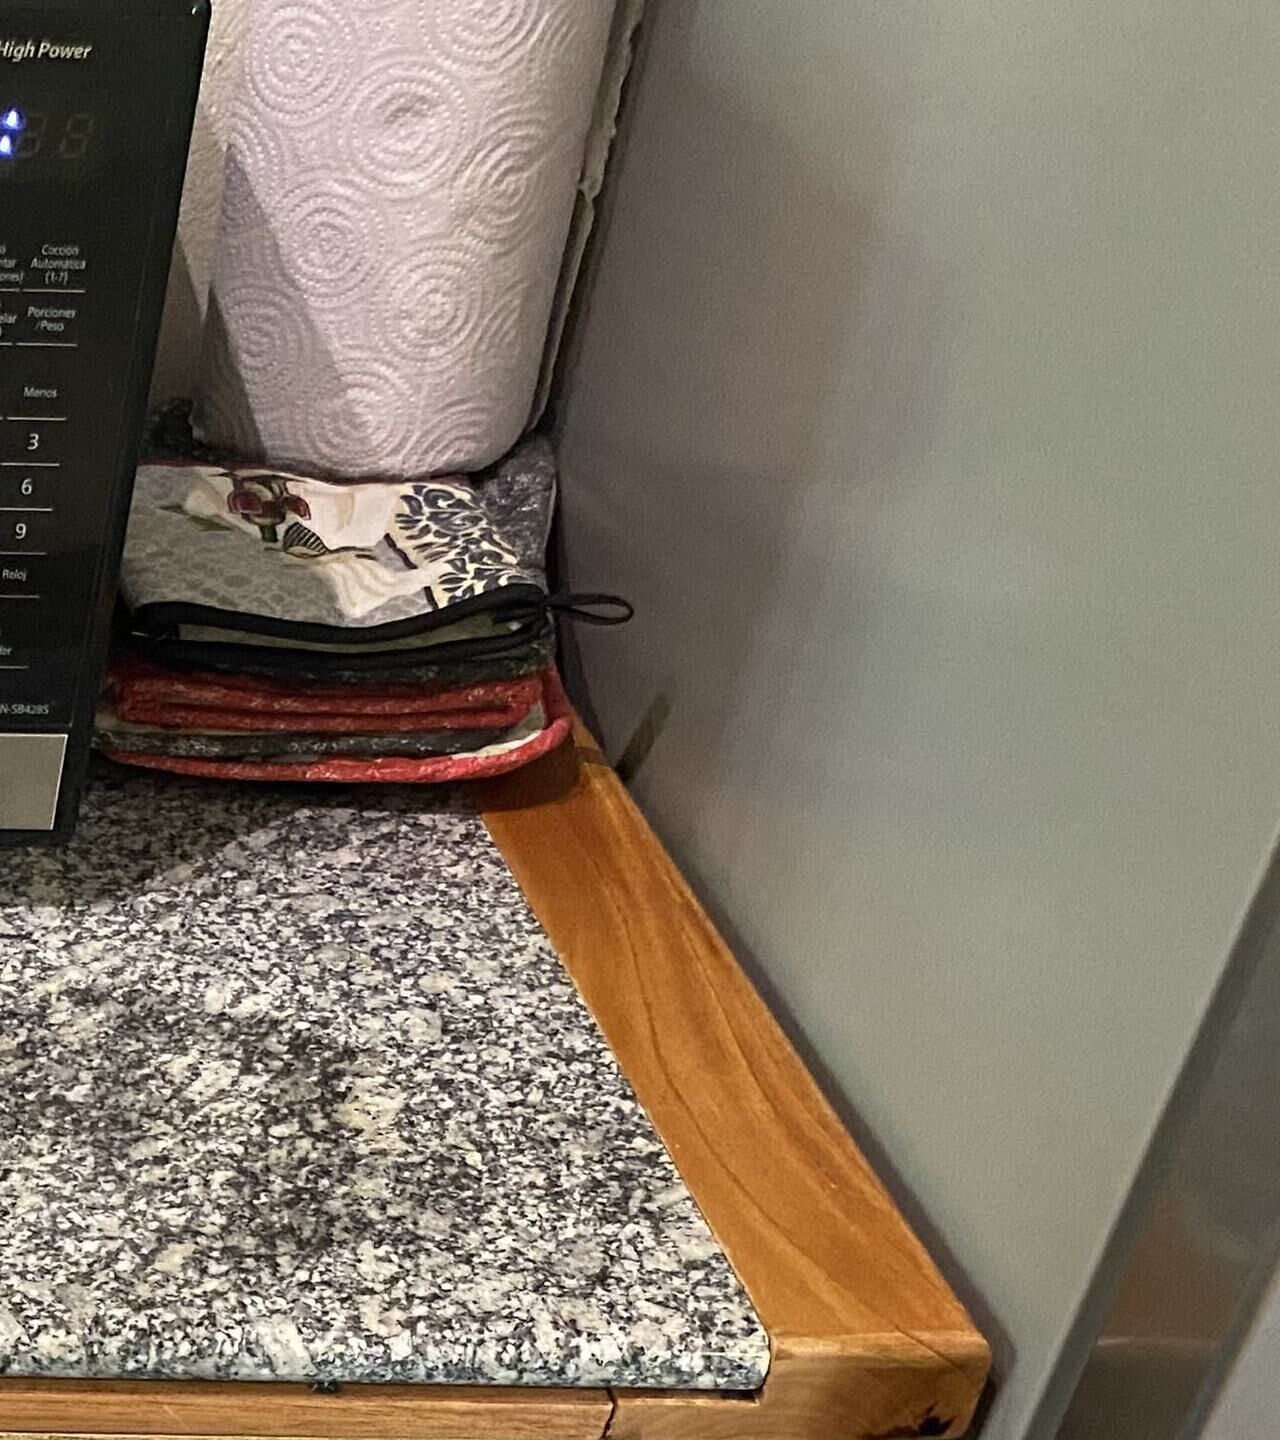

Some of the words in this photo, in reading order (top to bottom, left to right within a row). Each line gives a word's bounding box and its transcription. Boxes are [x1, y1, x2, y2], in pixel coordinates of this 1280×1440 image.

[37, 43, 92, 60] Power
[27, 306, 77, 319] Porciones
[23, 386, 58, 398] Menos
[27, 433, 40, 450] 3
[21, 478, 33, 495] 6
[15, 523, 27, 540] 9
[2, 569, 27, 581] Reloj
